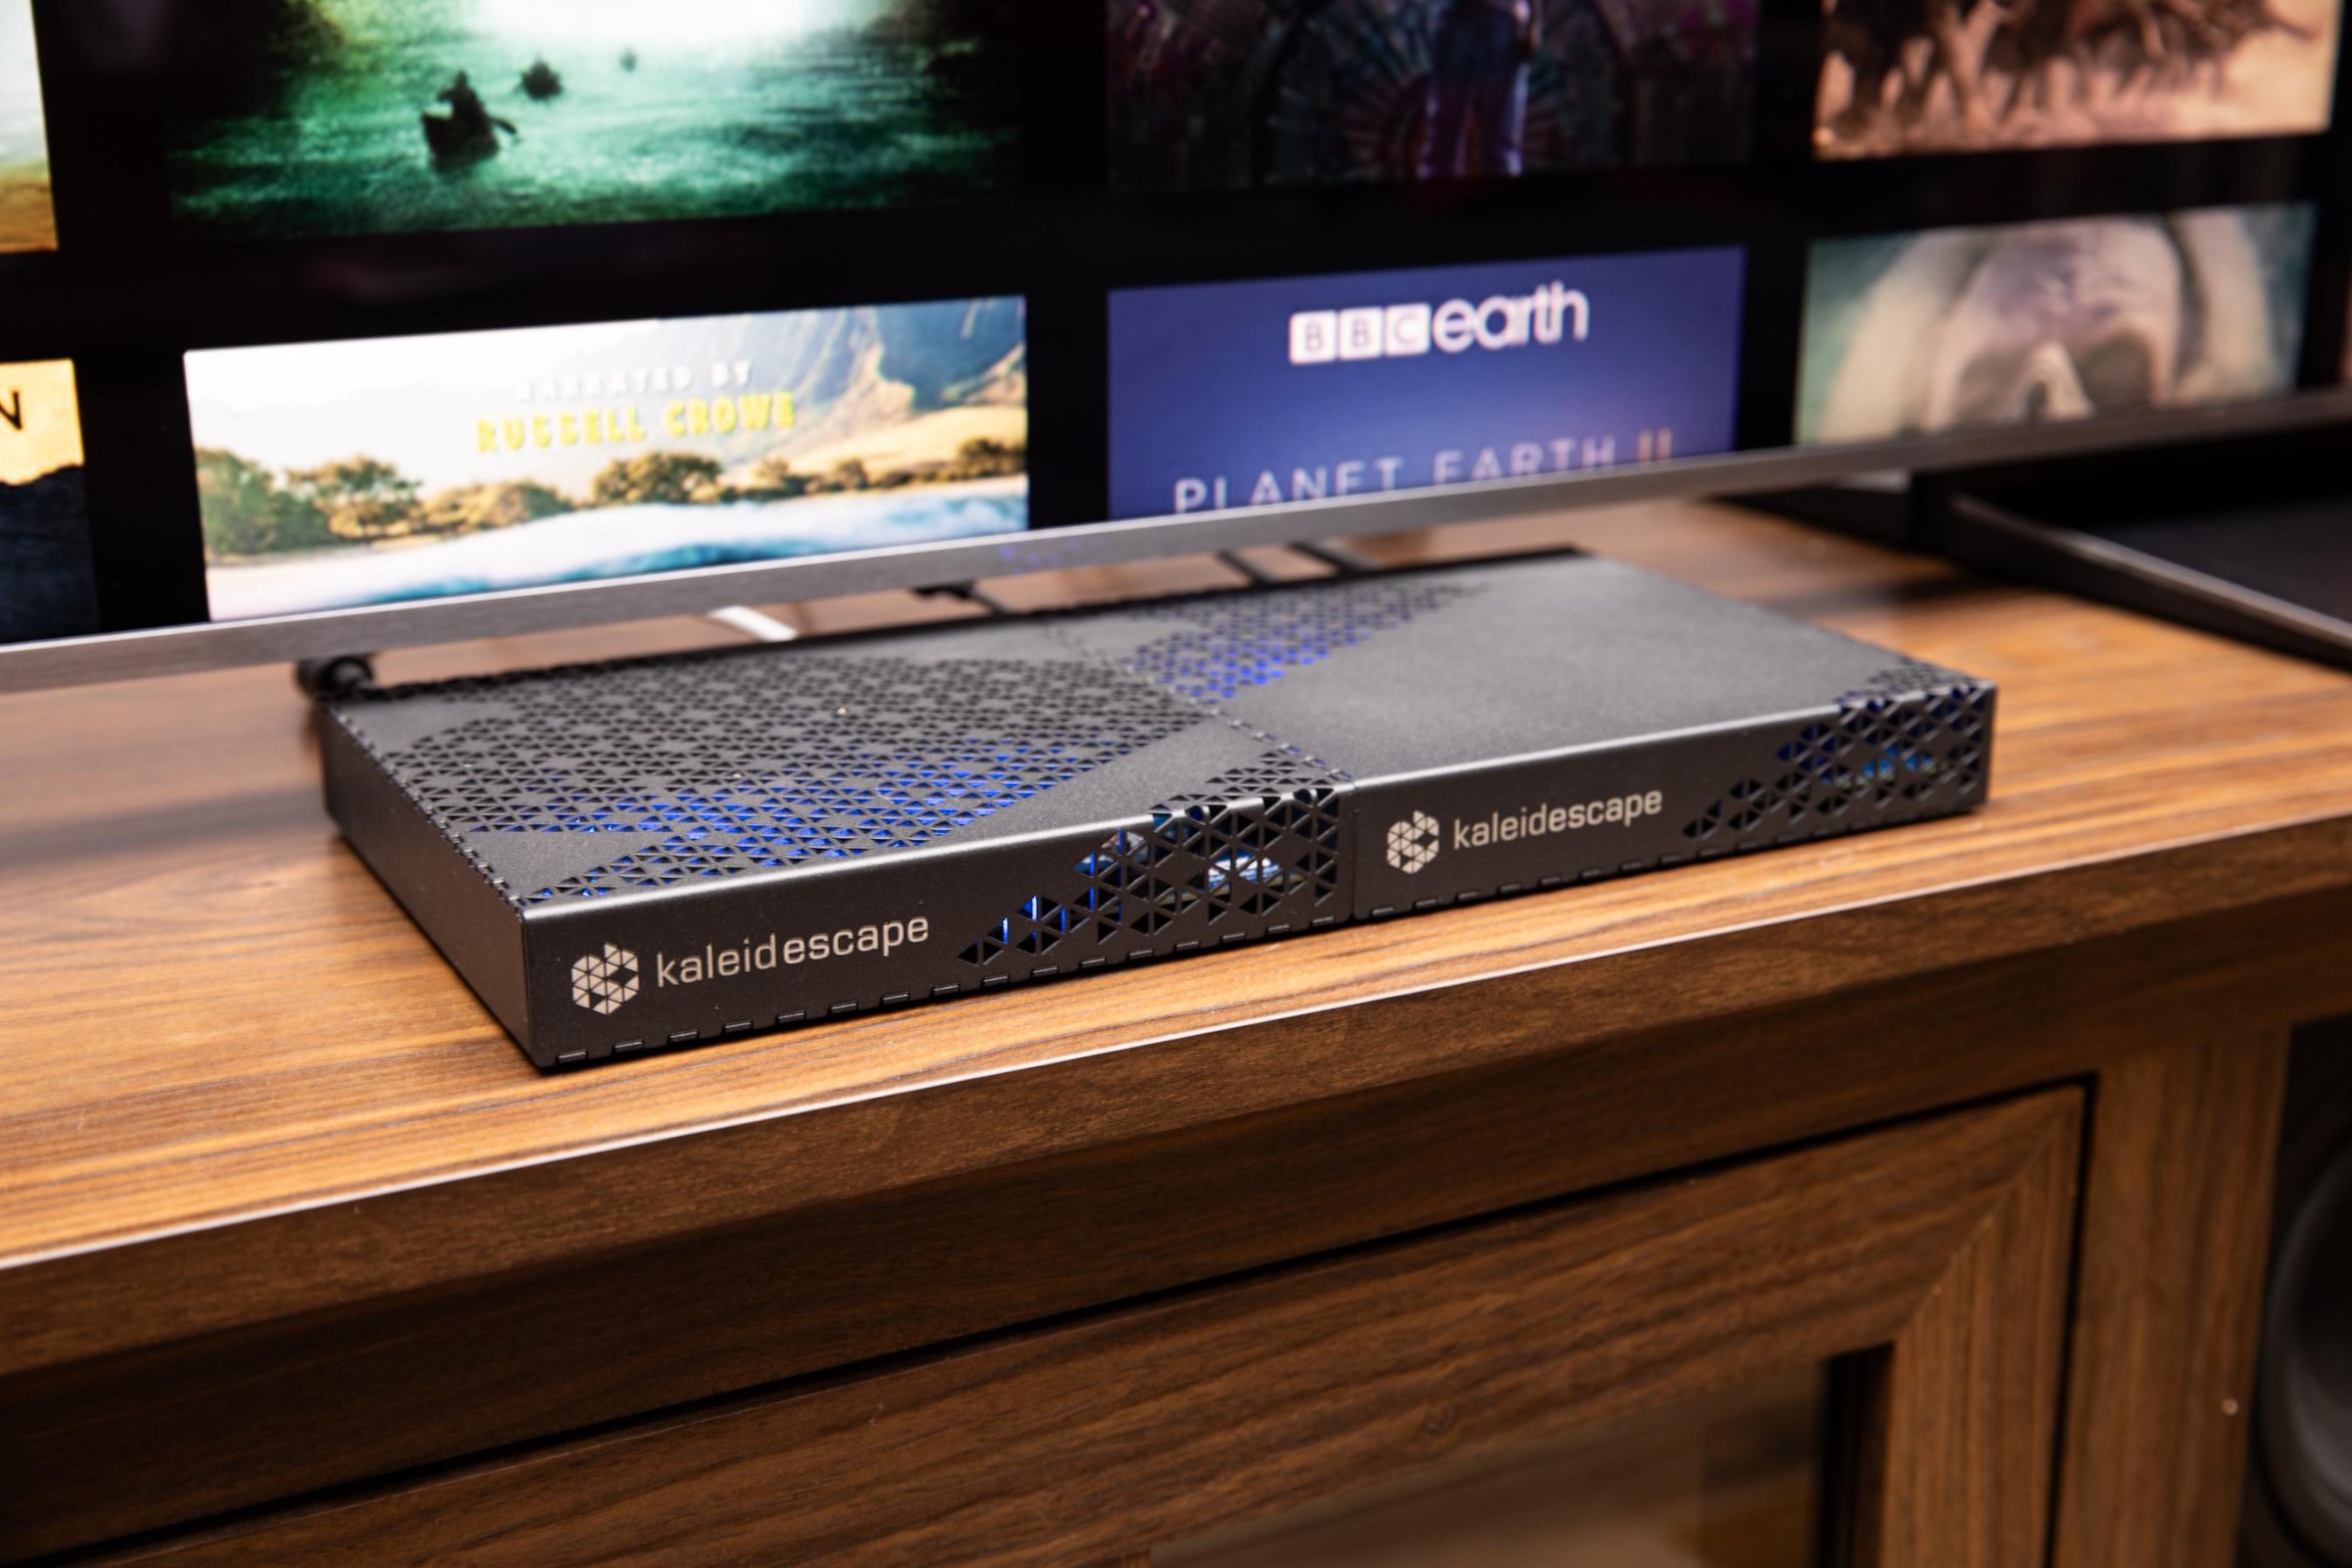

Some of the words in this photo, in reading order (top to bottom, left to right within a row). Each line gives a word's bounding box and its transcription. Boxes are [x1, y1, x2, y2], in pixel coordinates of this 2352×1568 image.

[1289, 302, 1432, 365] BBC
[1432, 280, 1590, 354] earth
[476, 405, 646, 452] RUSSELL
[665, 392, 796, 437] CROWE
[1453, 790, 1663, 850] kaleidescape
[657, 916, 930, 988] kaleidescape
